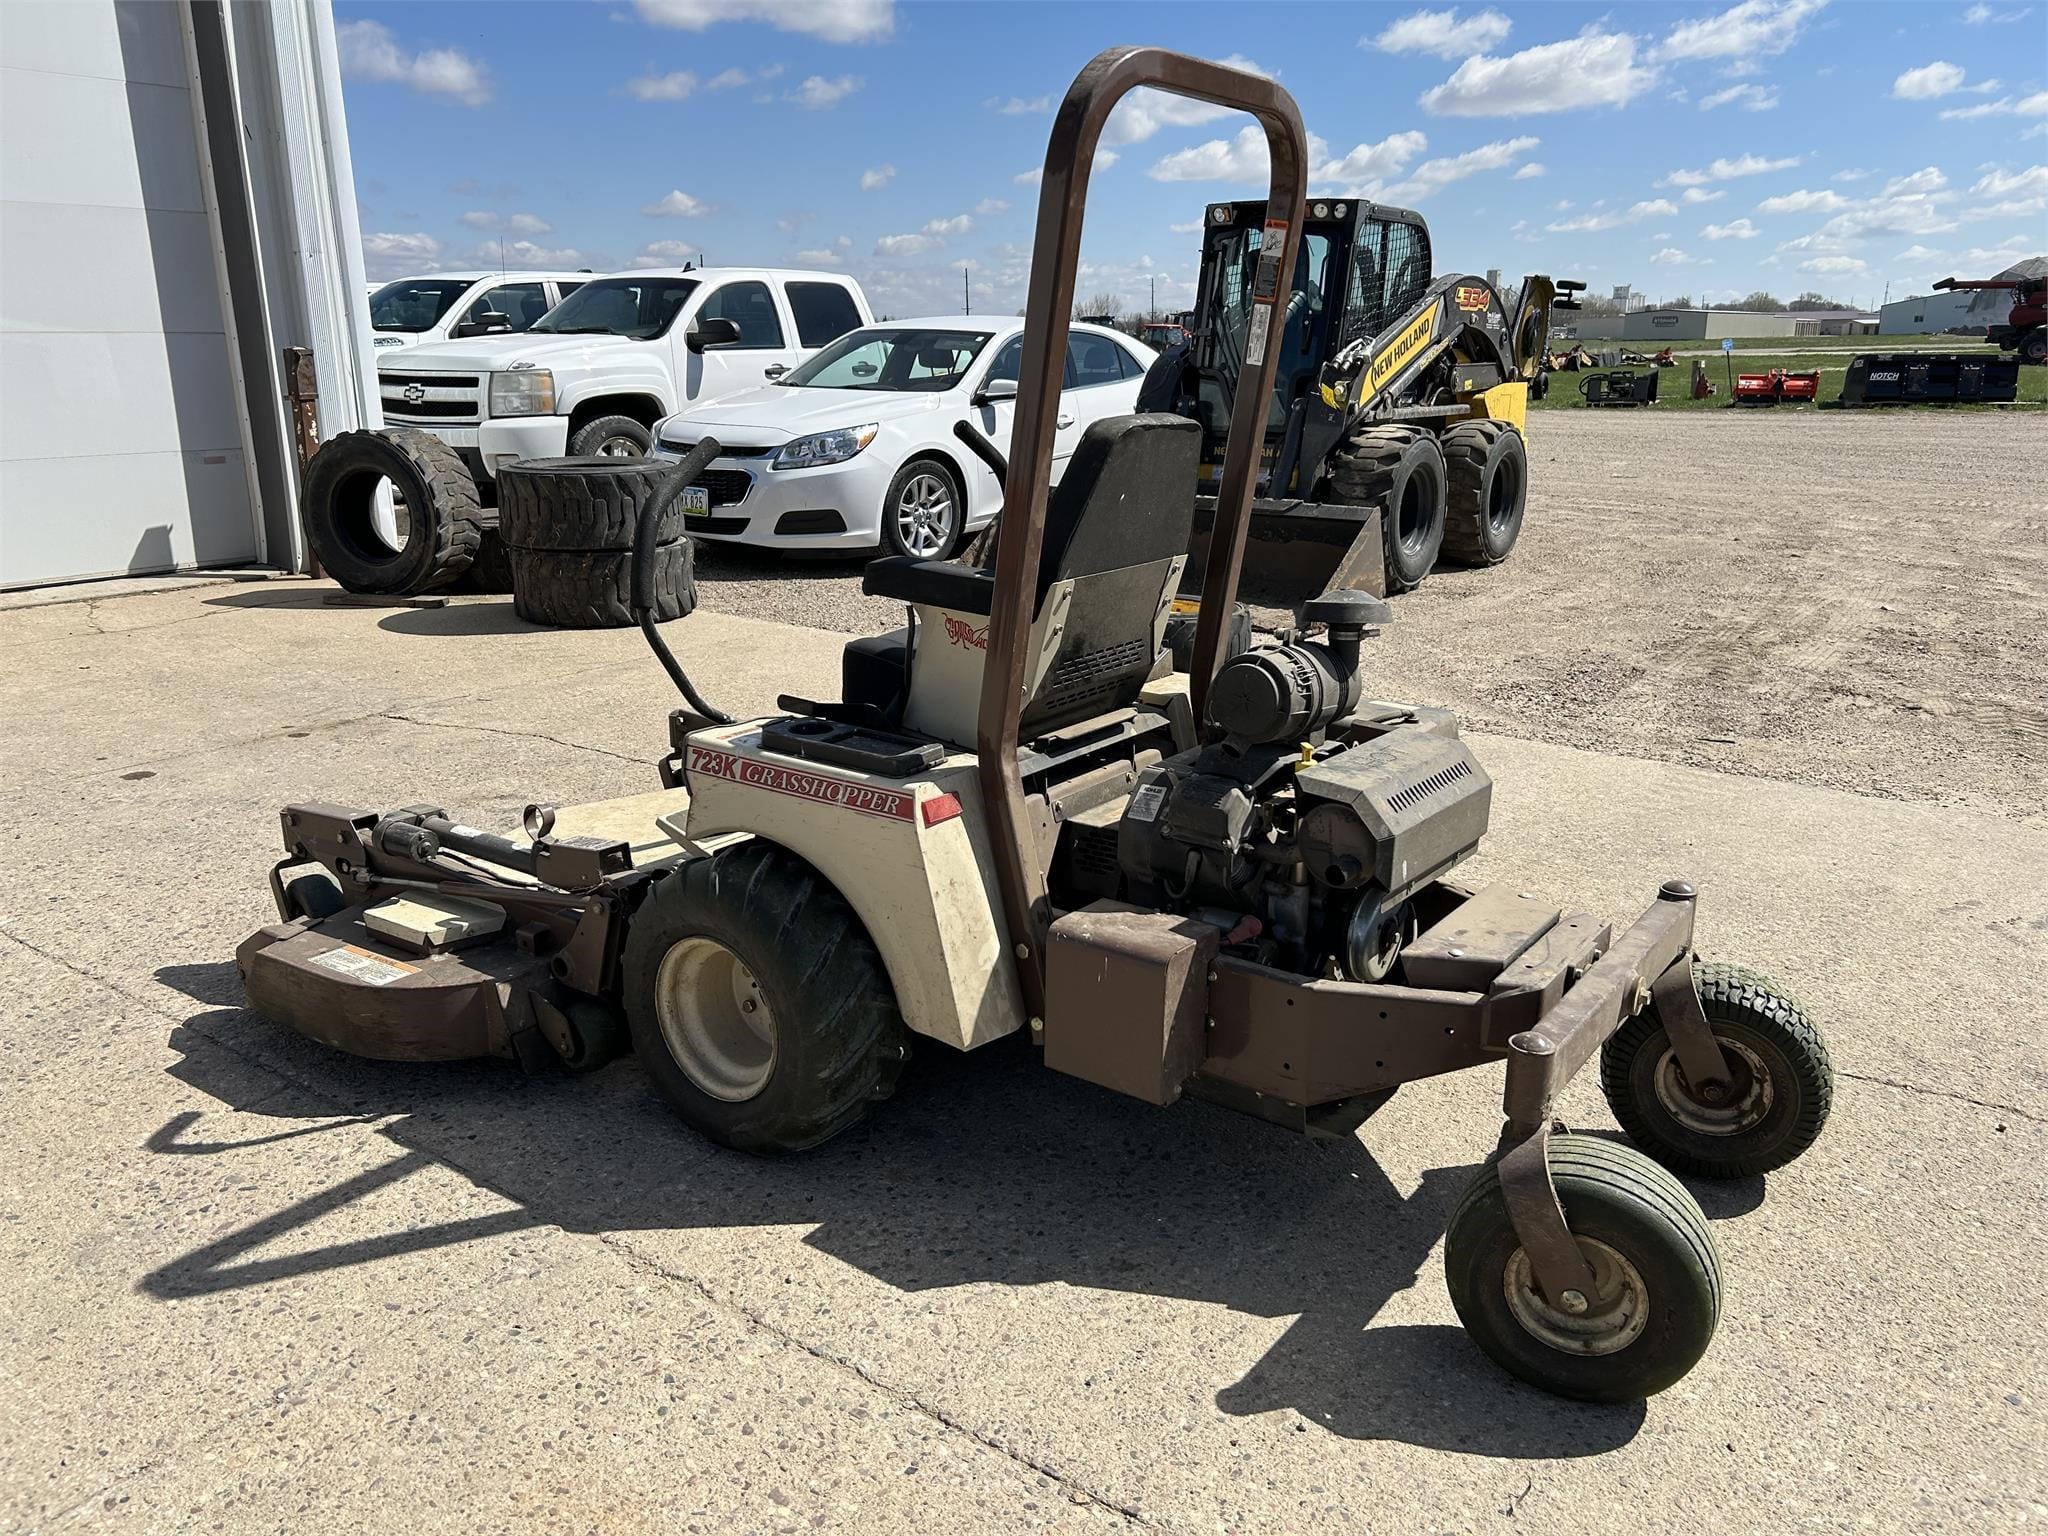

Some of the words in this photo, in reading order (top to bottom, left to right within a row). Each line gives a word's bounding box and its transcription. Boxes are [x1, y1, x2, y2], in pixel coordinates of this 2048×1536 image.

[1373, 351, 1393, 382] NEW
[1394, 317, 1430, 363] HOLLAND
[1870, 372, 1900, 381] NOTCH
[1213, 446, 1227, 456] NE
[690, 495, 703, 510] 825
[692, 749, 738, 779] 723K
[745, 764, 901, 815] GRASSHOPPER
